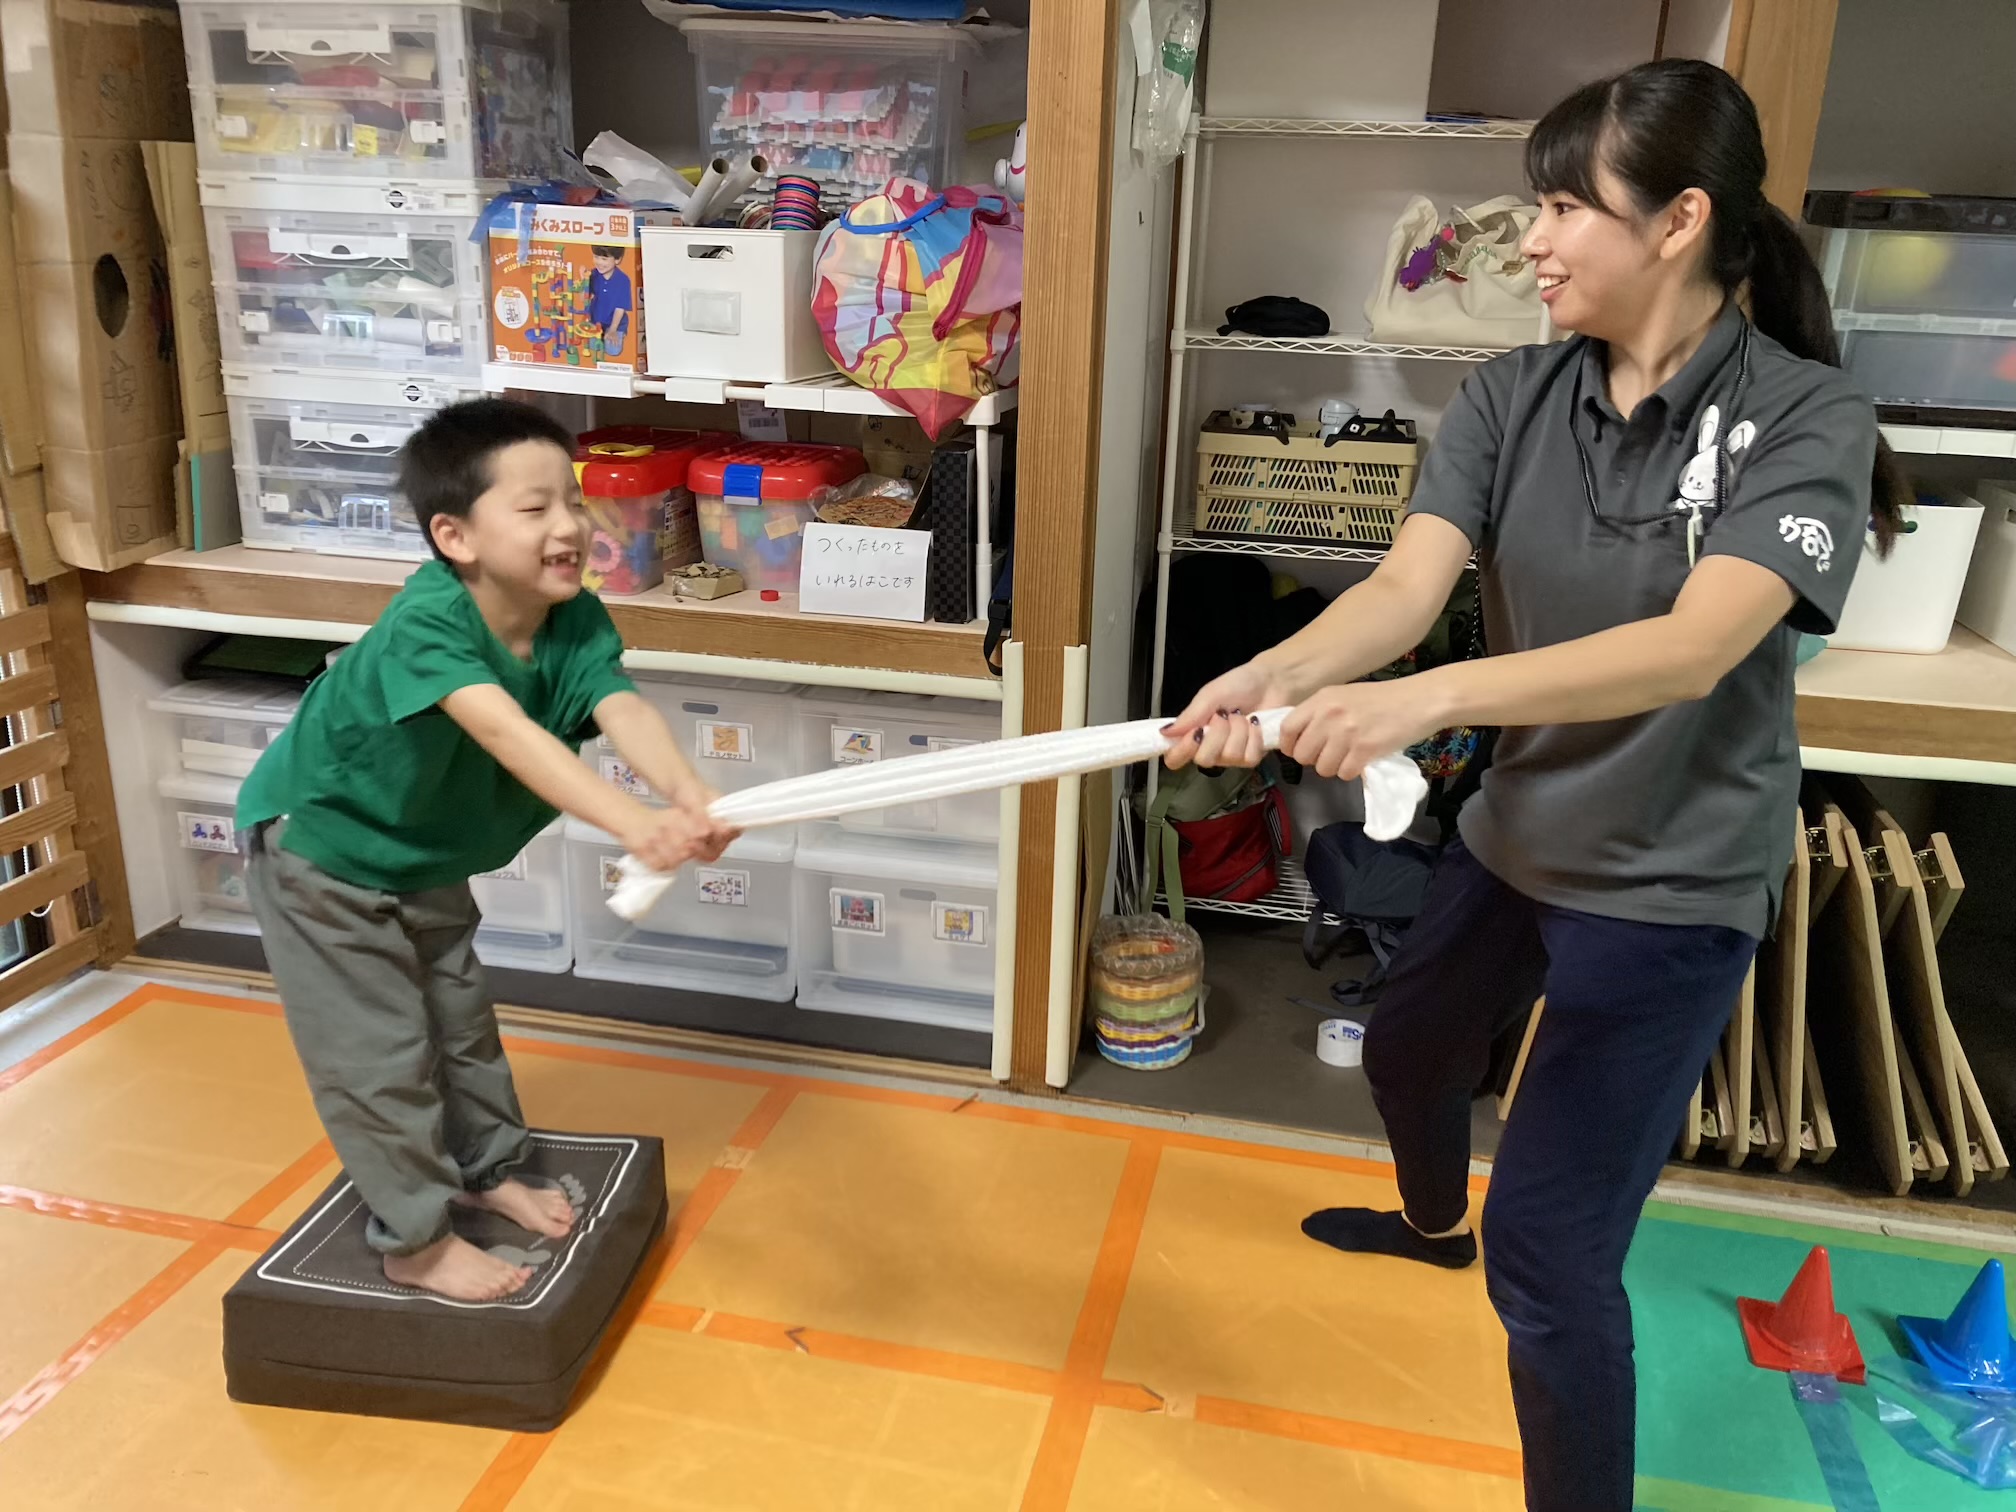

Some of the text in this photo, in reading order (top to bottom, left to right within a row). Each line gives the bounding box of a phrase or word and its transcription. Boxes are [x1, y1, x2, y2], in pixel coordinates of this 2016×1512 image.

[530, 217, 605, 235] みくみスロープ
[817, 537, 905, 555] つくったものを
[815, 574, 915, 589] いれるはこです
